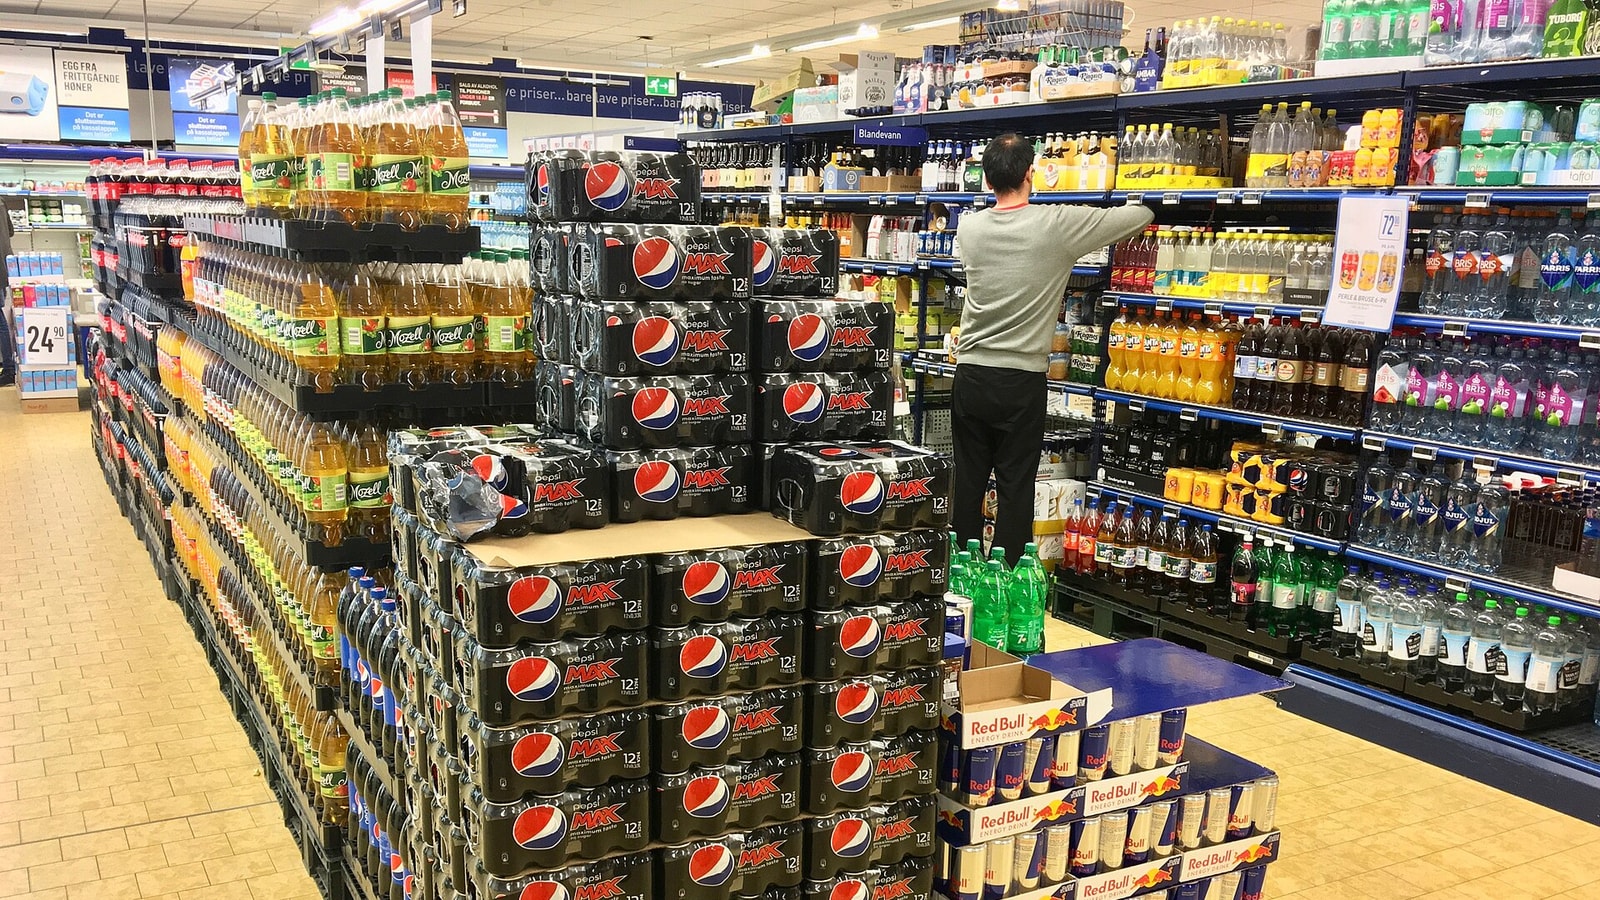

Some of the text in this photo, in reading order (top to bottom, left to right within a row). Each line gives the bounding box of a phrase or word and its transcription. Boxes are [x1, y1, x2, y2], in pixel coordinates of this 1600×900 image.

[1548, 12, 1583, 25] TUBORG
[62, 60, 97, 71] EGG FRA
[134, 59, 165, 75] lave
[64, 81, 92, 92] HØNER
[566, 90, 592, 102] bare
[663, 96, 680, 109] bar
[722, 101, 754, 113] riser...
[198, 116, 208, 124] Det
[859, 128, 902, 140] Blandevann
[636, 168, 659, 177] pepsi
[632, 178, 680, 199] MAX
[679, 202, 690, 216] 12
[1382, 215, 1395, 235] 72
[686, 242, 711, 252] pepsi
[782, 245, 802, 254] pepsi
[682, 252, 734, 275] MAX
[778, 254, 822, 275] MAX
[1454, 258, 1473, 269] BRIS
[1480, 259, 1497, 270] BRIS
[732, 278, 742, 292] 12
[685, 321, 709, 330] pepsi
[835, 318, 857, 328] pepsi
[27, 325, 64, 353] 24 90
[388, 330, 423, 347] Mozell
[432, 323, 463, 343] Mozell
[831, 325, 878, 346] MAX
[682, 329, 733, 351] MAX
[874, 348, 886, 361] 12
[685, 388, 710, 398] pepsi
[829, 385, 853, 394] pepsi
[1466, 383, 1486, 394] BRIS
[682, 395, 733, 416] MAX
[827, 391, 873, 411] MAX
[871, 411, 882, 421] 12
[684, 461, 710, 470] pepsi
[535, 473, 561, 483] pepsi
[683, 466, 732, 488] MAX
[889, 472, 913, 481] pepsi
[350, 480, 382, 501] Mozell
[533, 477, 586, 502] MAX
[730, 486, 742, 498] 12
[886, 477, 935, 500] MAX
[887, 544, 911, 554] pepsi
[736, 561, 762, 570] pepsi
[884, 549, 933, 572] MAX
[568, 573, 597, 585] pepsi
[733, 563, 786, 589] MAX
[565, 578, 625, 606] MAX
[565, 604, 599, 612] maximum
[623, 600, 637, 613] 12
[886, 612, 909, 622] pepsi
[883, 617, 930, 641] MAX
[732, 633, 758, 643] pepsi
[729, 636, 783, 662] MAX
[567, 653, 595, 664] pepsi
[563, 657, 623, 685] MAX
[884, 680, 907, 690] pepsi
[881, 683, 928, 707] MAX
[735, 703, 760, 713] pepsi
[732, 705, 784, 732] MAX
[972, 713, 1025, 736] Red Bull
[571, 728, 599, 740] pepsi
[971, 730, 1024, 744] ENERGY DRINK
[567, 730, 625, 760] MAX
[623, 753, 637, 764] 12
[878, 747, 901, 757] pepsi
[875, 751, 921, 776] MAX
[735, 771, 760, 781] pepsi
[918, 770, 929, 780] 12
[732, 773, 783, 800] MAX
[1091, 782, 1137, 803] Red Bull
[573, 800, 600, 811] pepsi
[1090, 797, 1136, 811] ENERGY DRINK
[570, 802, 627, 831] MAX
[876, 814, 899, 824] pepsi
[981, 808, 1030, 829] Red Bull
[873, 815, 918, 841] MAX
[980, 821, 1028, 837] ENERGY DRINK
[740, 839, 764, 849] pepsi
[737, 839, 788, 867] MAX
[1188, 850, 1231, 870] Red Bull
[1187, 863, 1230, 878] ENERGY DRINK
[575, 873, 602, 885] pepsi
[874, 874, 897, 884] pepsi
[574, 874, 628, 900] MAX
[872, 876, 916, 900] MAX
[1084, 875, 1129, 897] Red Bull
